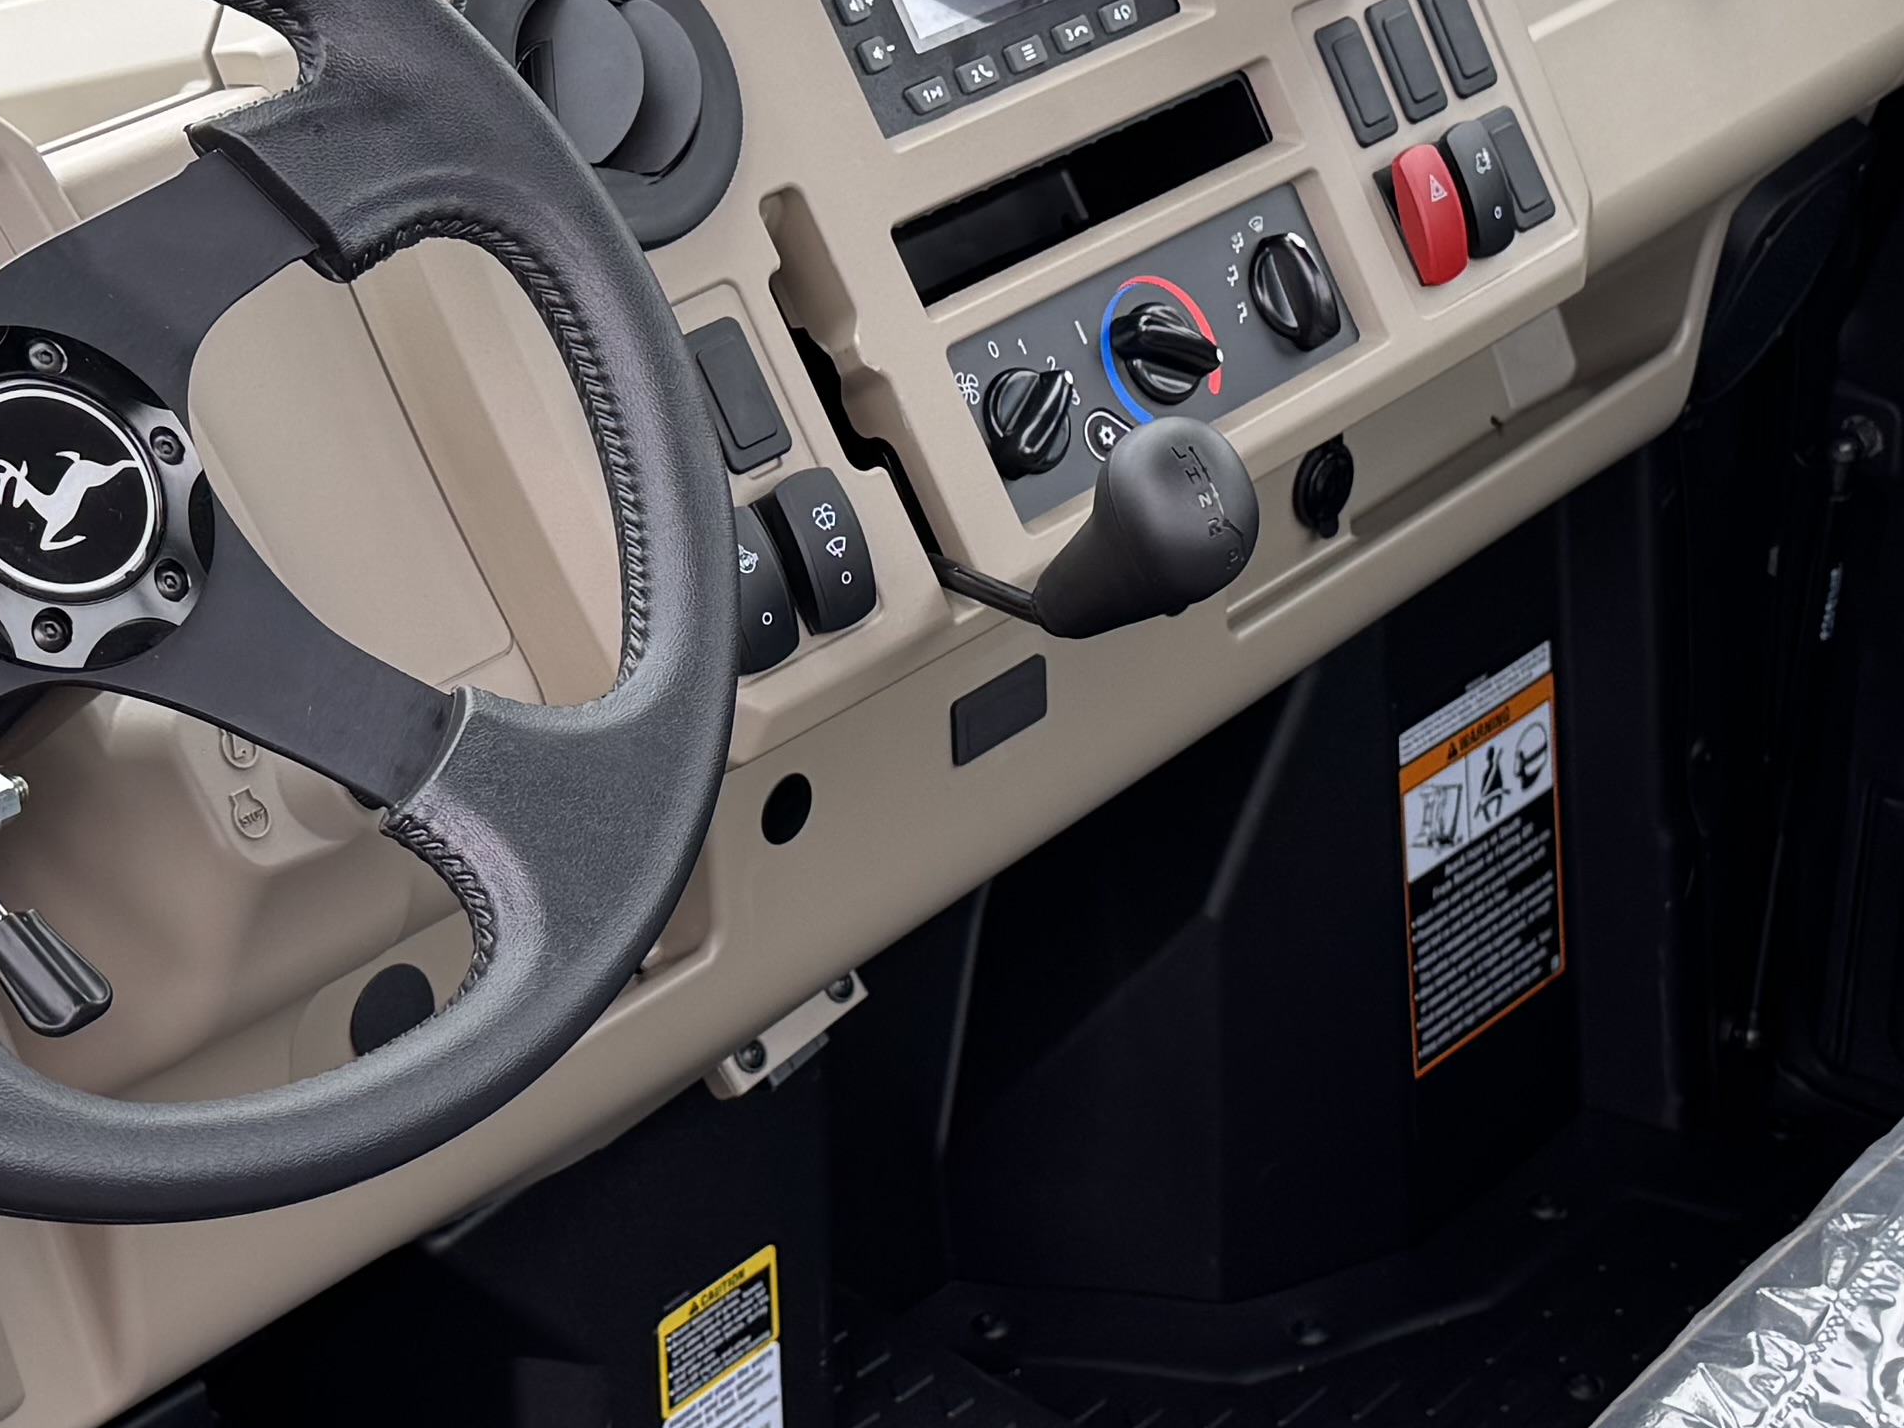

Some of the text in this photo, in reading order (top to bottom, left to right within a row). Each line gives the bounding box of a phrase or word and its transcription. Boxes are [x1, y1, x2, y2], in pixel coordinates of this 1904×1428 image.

[1017, 338, 1027, 355] 1
[1171, 446, 1187, 459] L
[1184, 466, 1202, 484] H
[1198, 492, 1213, 508] N
[1207, 517, 1223, 537] R
[1458, 708, 1511, 752] WARNING
[699, 1266, 747, 1308] CAUTION
